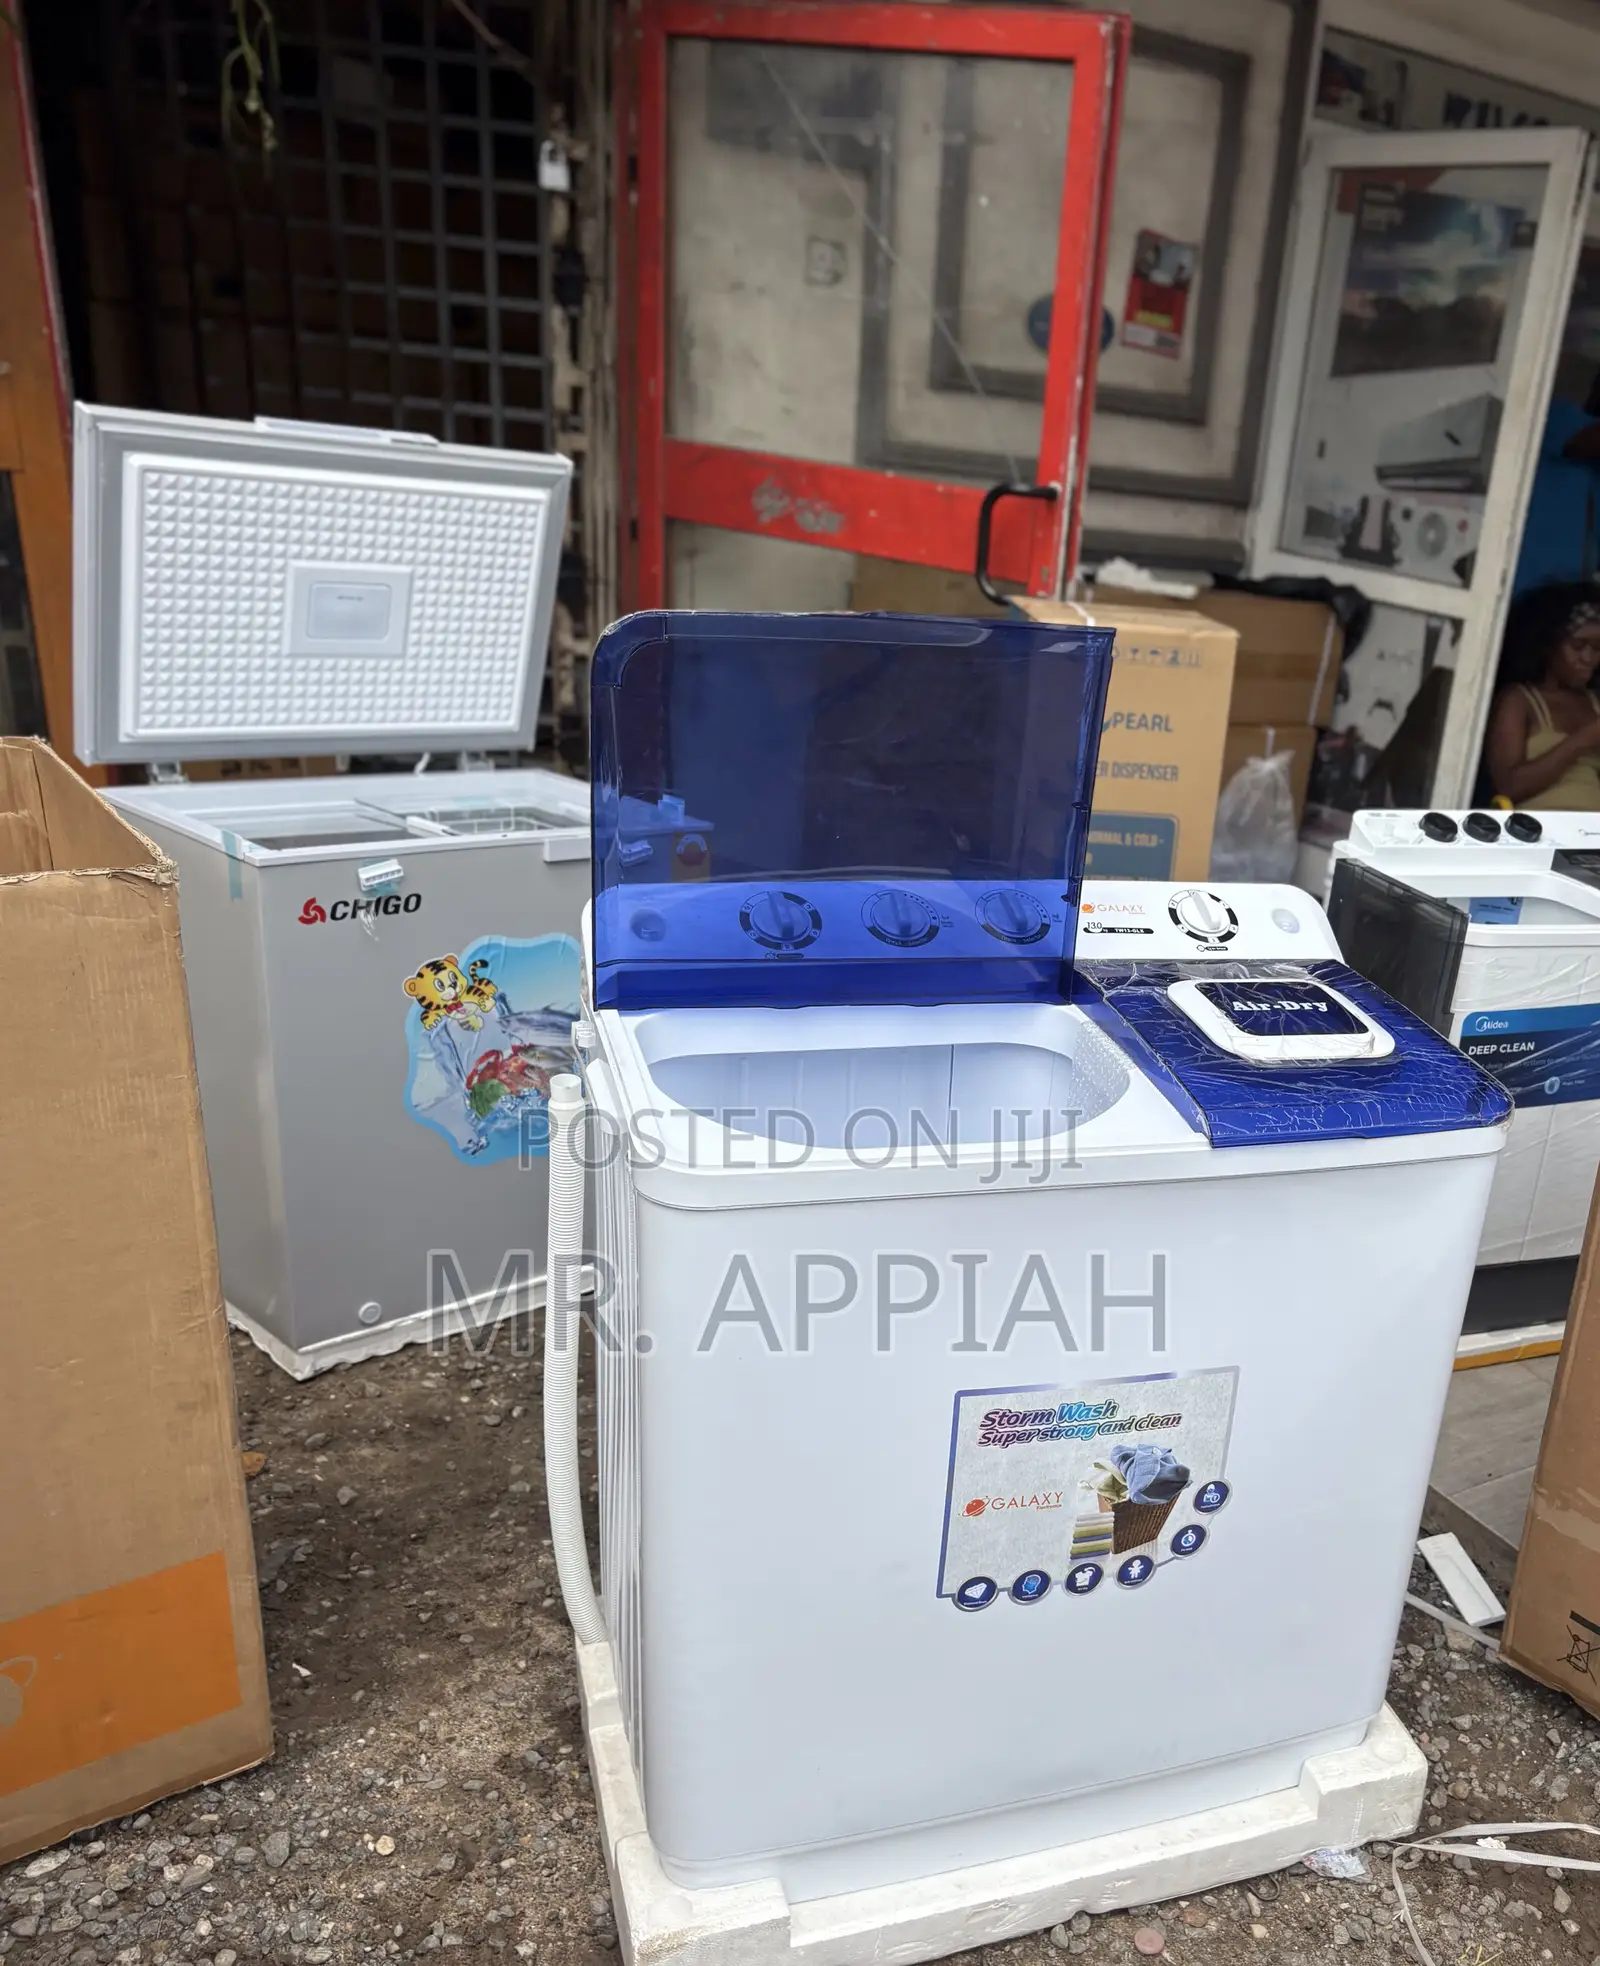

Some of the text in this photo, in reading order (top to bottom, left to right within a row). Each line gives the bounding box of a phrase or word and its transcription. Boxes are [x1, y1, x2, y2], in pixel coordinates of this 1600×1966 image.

[1111, 711, 1174, 733] PEARL
[1111, 761, 1178, 782] DISPENSER
[329, 892, 423, 922] CHIGO
[1097, 903, 1145, 913] GALAXY
[1231, 1000, 1329, 1012] Air-Dry
[1476, 1017, 1509, 1032] Midea
[1468, 1041, 1536, 1056] DEEP CLEAN
[980, 1399, 1120, 1429] Storm Wash
[978, 1413, 1183, 1448] Super strong and clean
[990, 1491, 1064, 1511] GALAXY
